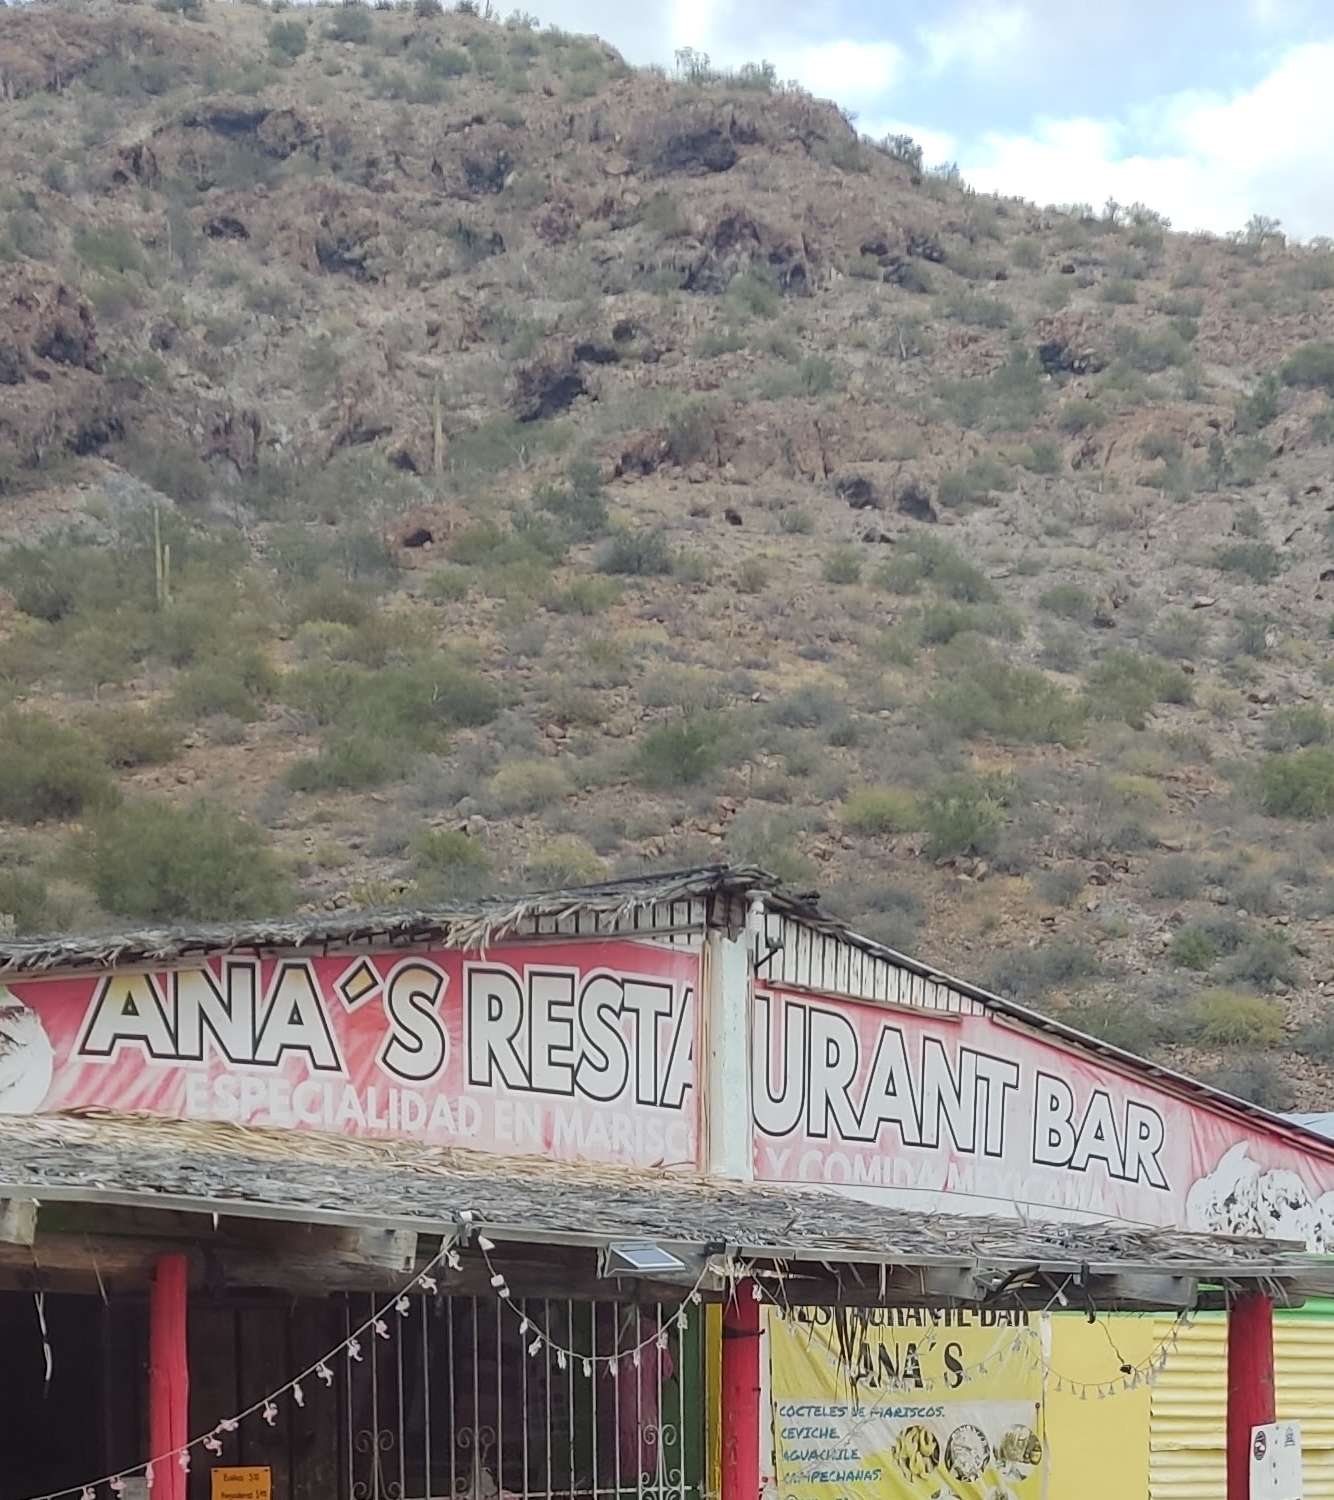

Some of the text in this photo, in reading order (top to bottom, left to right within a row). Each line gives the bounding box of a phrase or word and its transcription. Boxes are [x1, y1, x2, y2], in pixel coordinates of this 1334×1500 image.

[185, 1072, 483, 1138] ESPECIALIDAD
[494, 1100, 542, 1141] EN
[765, 1146, 790, 1177] Y
[798, 1149, 937, 1189] COMIDA
[1033, 1071, 1170, 1191] BAR
[779, 1404, 848, 1418] COCTELES
